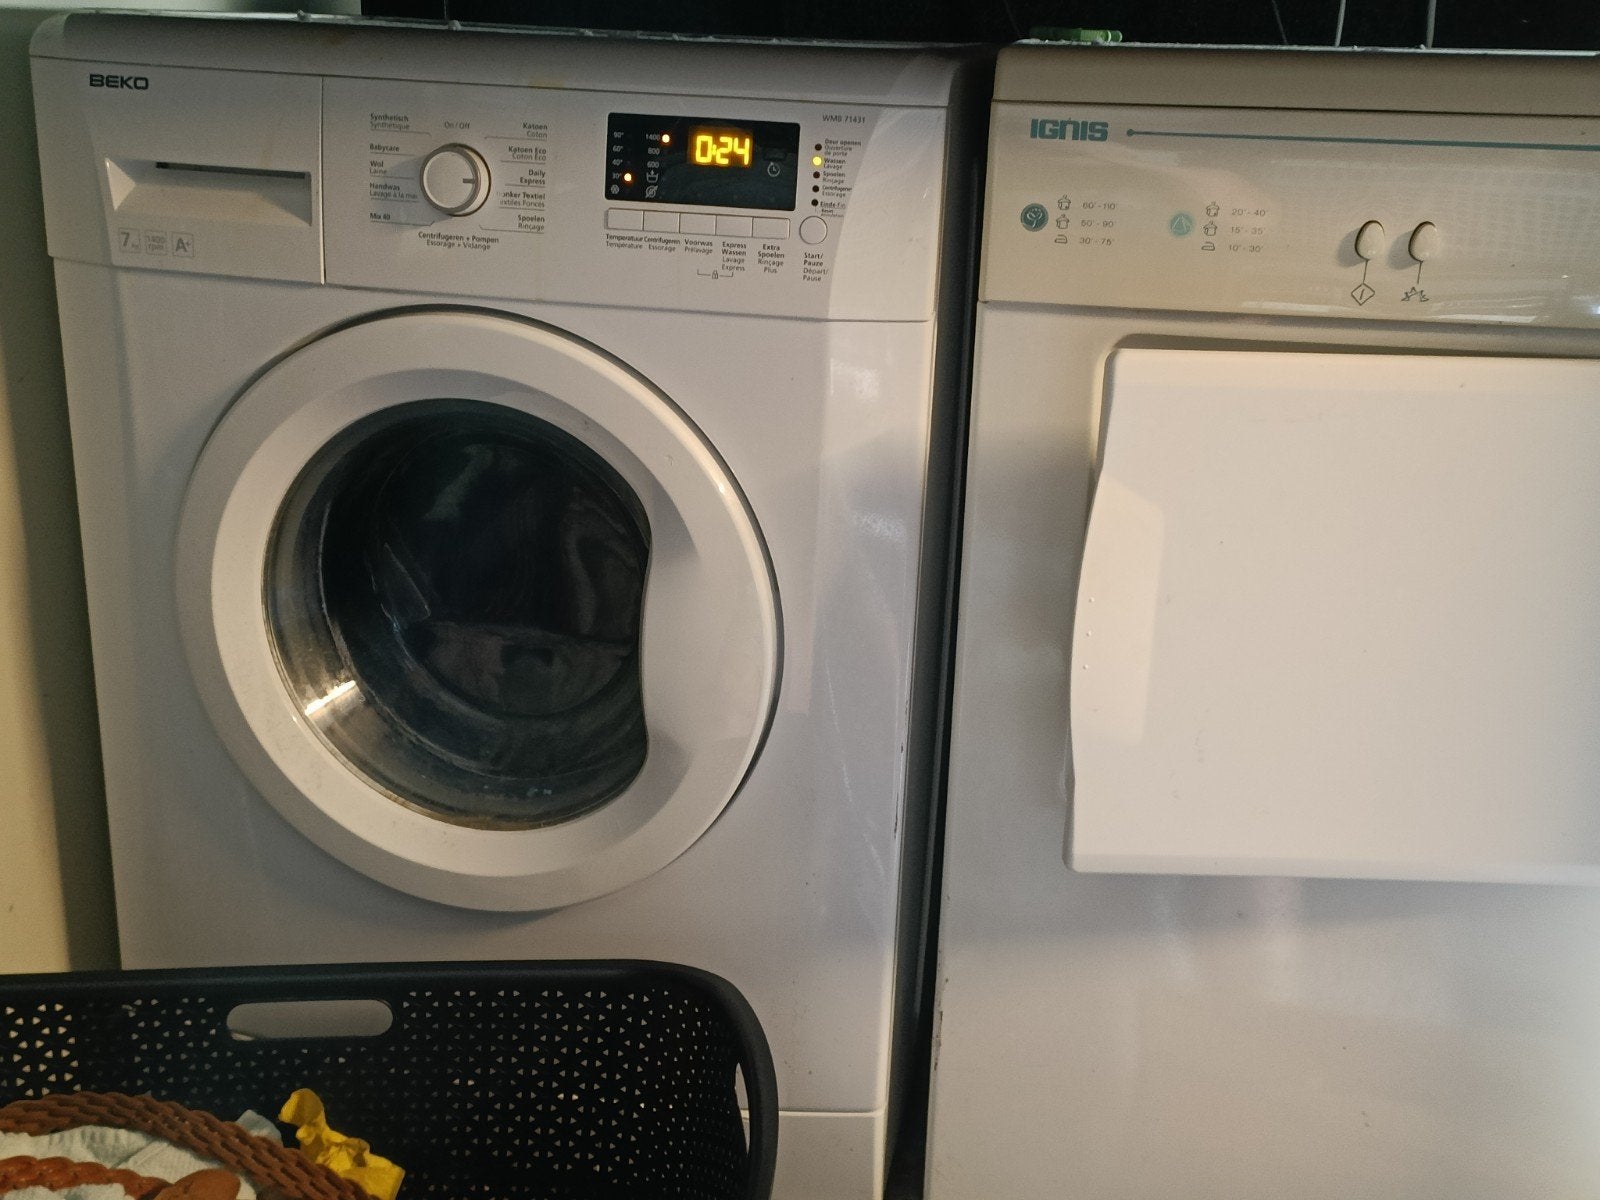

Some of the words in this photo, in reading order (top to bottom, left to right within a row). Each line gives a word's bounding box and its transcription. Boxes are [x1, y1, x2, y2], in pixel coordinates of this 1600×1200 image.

[89, 74, 149, 90] BEKO
[370, 112, 409, 122] Synthetisch
[822, 114, 842, 123] WMB
[844, 115, 865, 124] 71431
[444, 121, 455, 129] On
[459, 121, 470, 130] Off
[523, 122, 548, 131] Katoen
[1030, 118, 1109, 142] IGNIS
[526, 131, 547, 139] Coton
[645, 133, 661, 142] 1400
[369, 143, 400, 152] Babycare
[508, 146, 533, 154] Katoen
[535, 147, 547, 155] Eco
[647, 146, 661, 155] 800
[694, 134, 751, 167] 0:24
[512, 153, 533, 161] Coton
[370, 160, 384, 168] Wol
[646, 160, 660, 169] 600
[528, 169, 546, 178] Daily
[519, 177, 546, 186] Express
[369, 182, 400, 191] Handwas
[522, 192, 546, 200] Textiel
[369, 212, 381, 220] Mix
[517, 214, 545, 223] Spoelen
[517, 223, 544, 231] Rinçage
[120, 231, 130, 247] 7
[417, 231, 464, 241] Centrifugeren
[471, 235, 500, 244] Pompen
[606, 233, 642, 242] Temperatuur
[426, 239, 455, 249] Essorage
[684, 238, 713, 247] Voorwas
[722, 241, 747, 250] Express
[762, 243, 780, 251] Extra
[722, 256, 745, 264] Lavage
[757, 251, 785, 260] Spoelen
[804, 251, 824, 260] Start/
[803, 259, 824, 267] Pauze
[722, 264, 746, 272] Express
